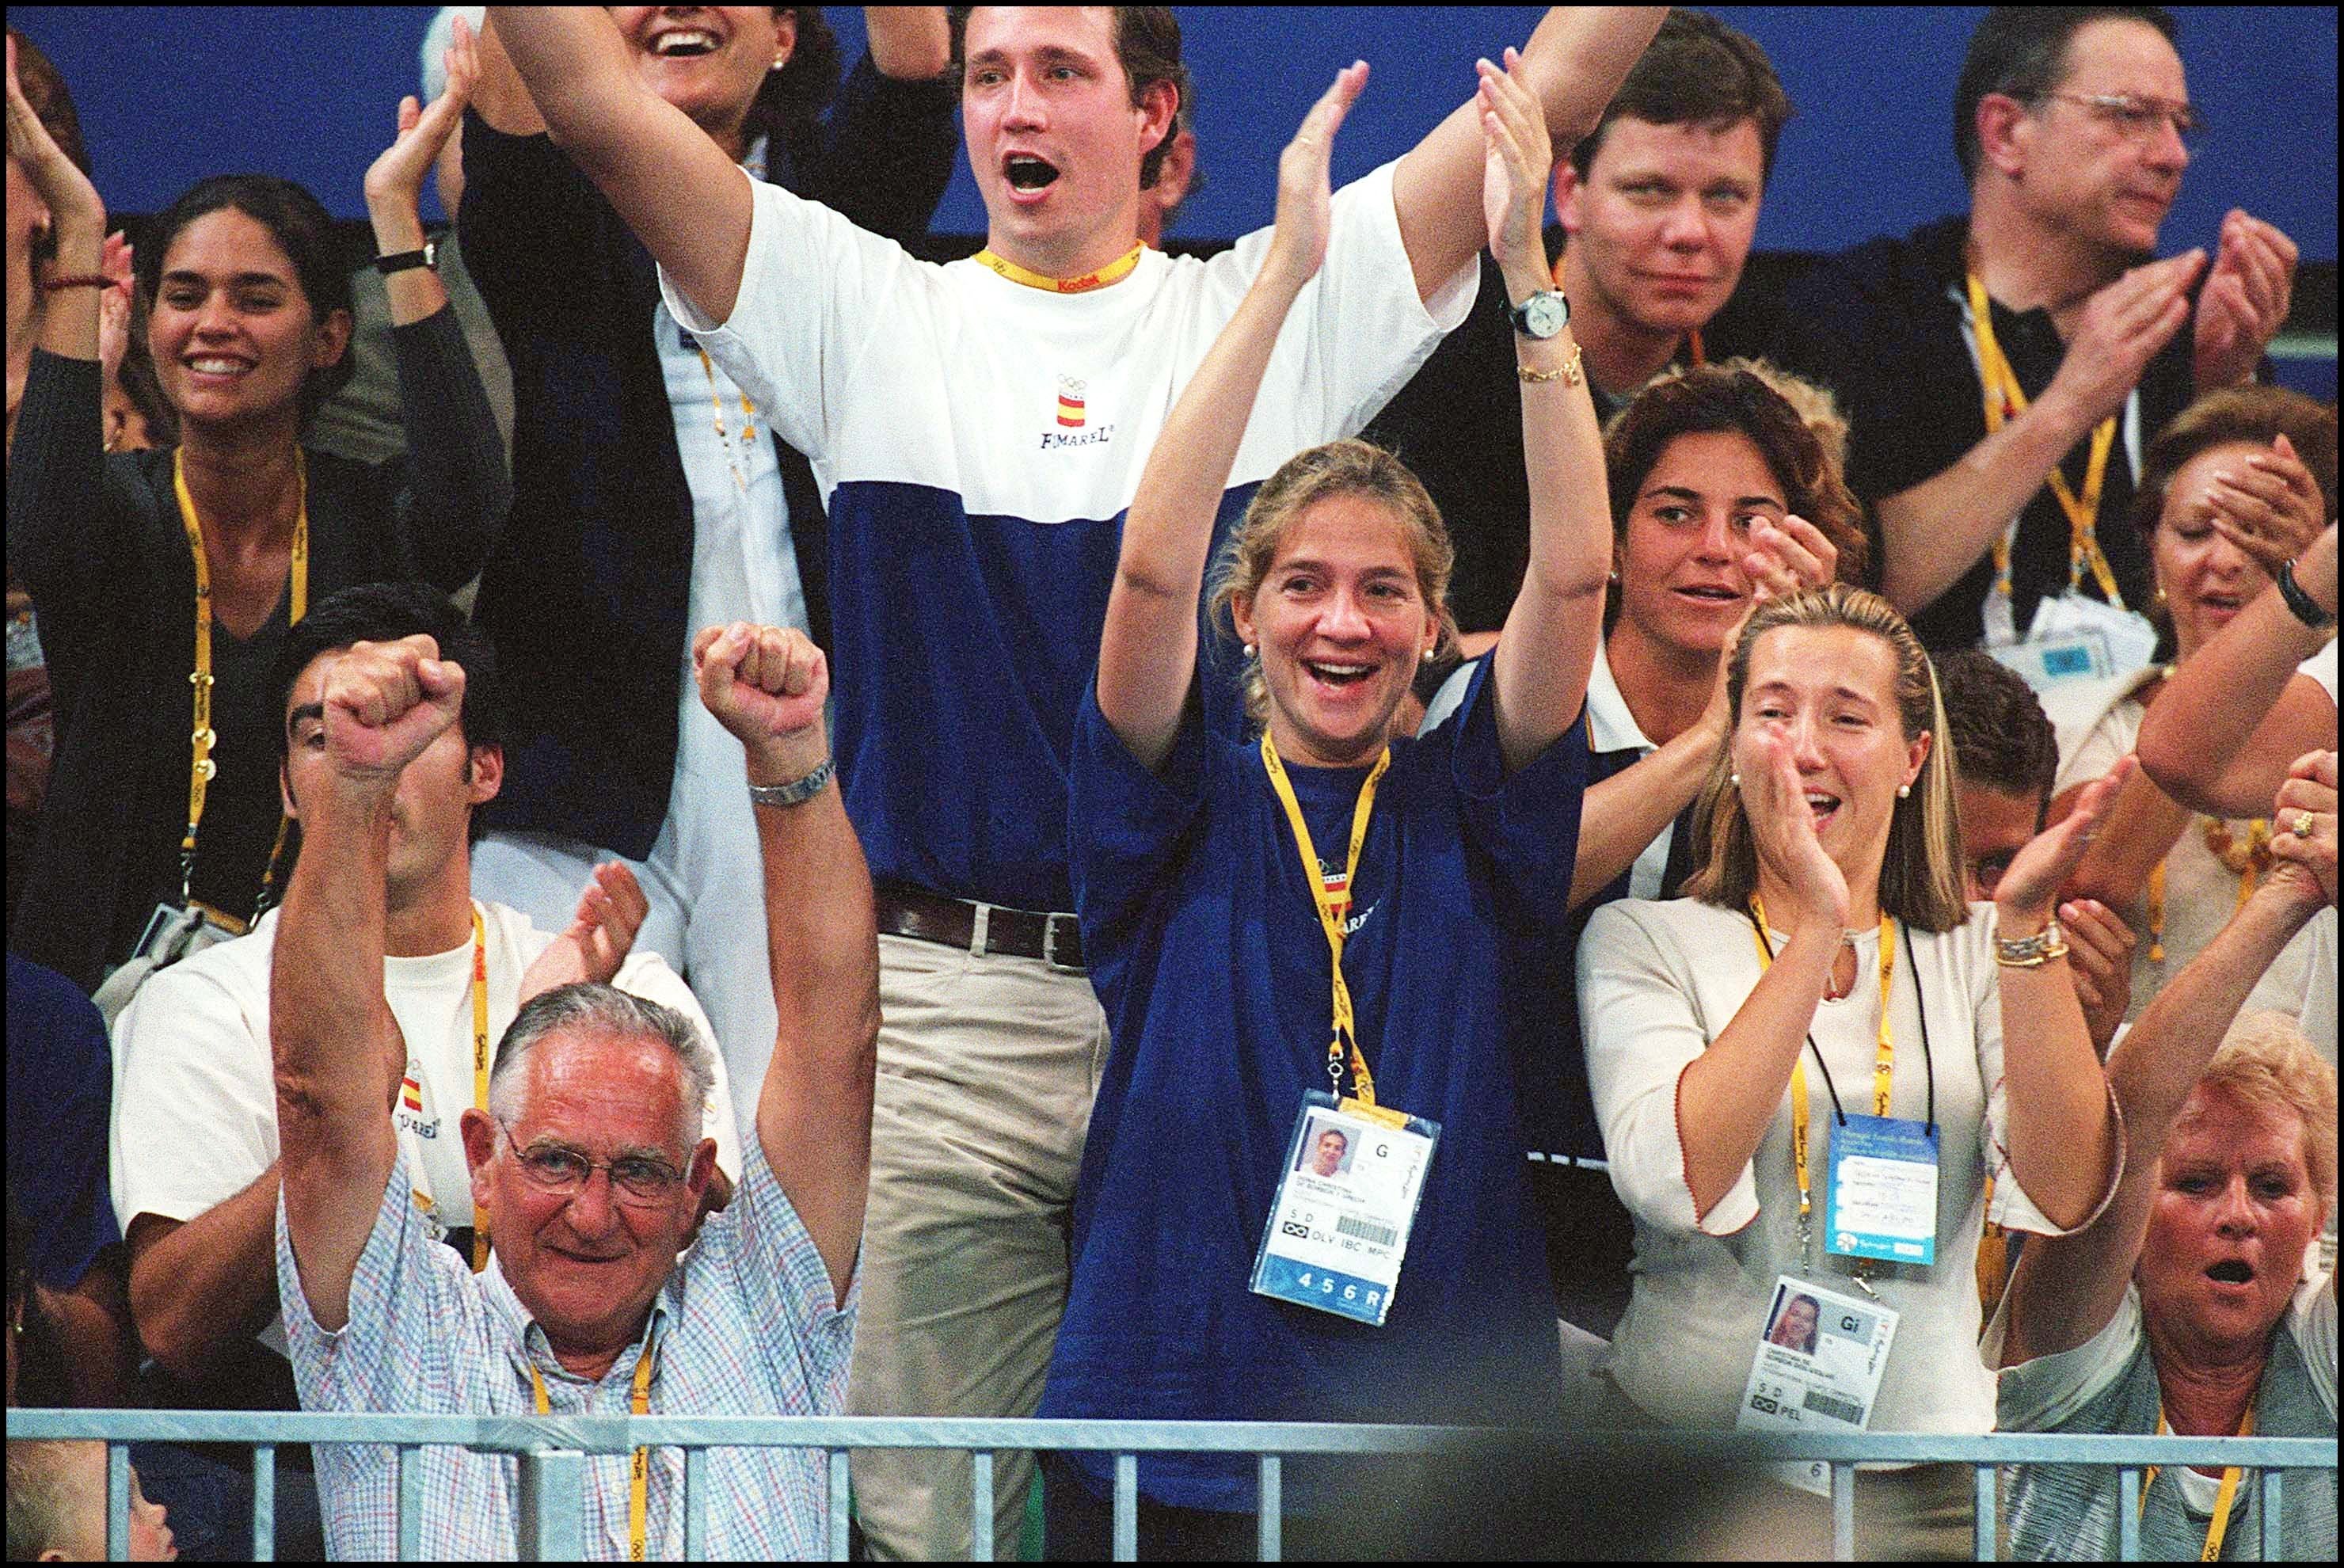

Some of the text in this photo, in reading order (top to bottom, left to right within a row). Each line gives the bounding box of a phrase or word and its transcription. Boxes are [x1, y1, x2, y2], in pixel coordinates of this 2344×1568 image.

[1058, 275, 1099, 291] Kodak
[1376, 1144, 1389, 1158] G
[1290, 1208, 1313, 1223] S D
[1341, 1239, 1363, 1252] IBC
[1368, 1246, 1391, 1260] MPC
[1298, 1273, 1380, 1307] 4 5 6 R
[1840, 1315, 1859, 1333] Gi
[1759, 1382, 1782, 1397] S D
[1781, 1406, 1801, 1421] PEL
[1811, 1463, 1822, 1478] 6
